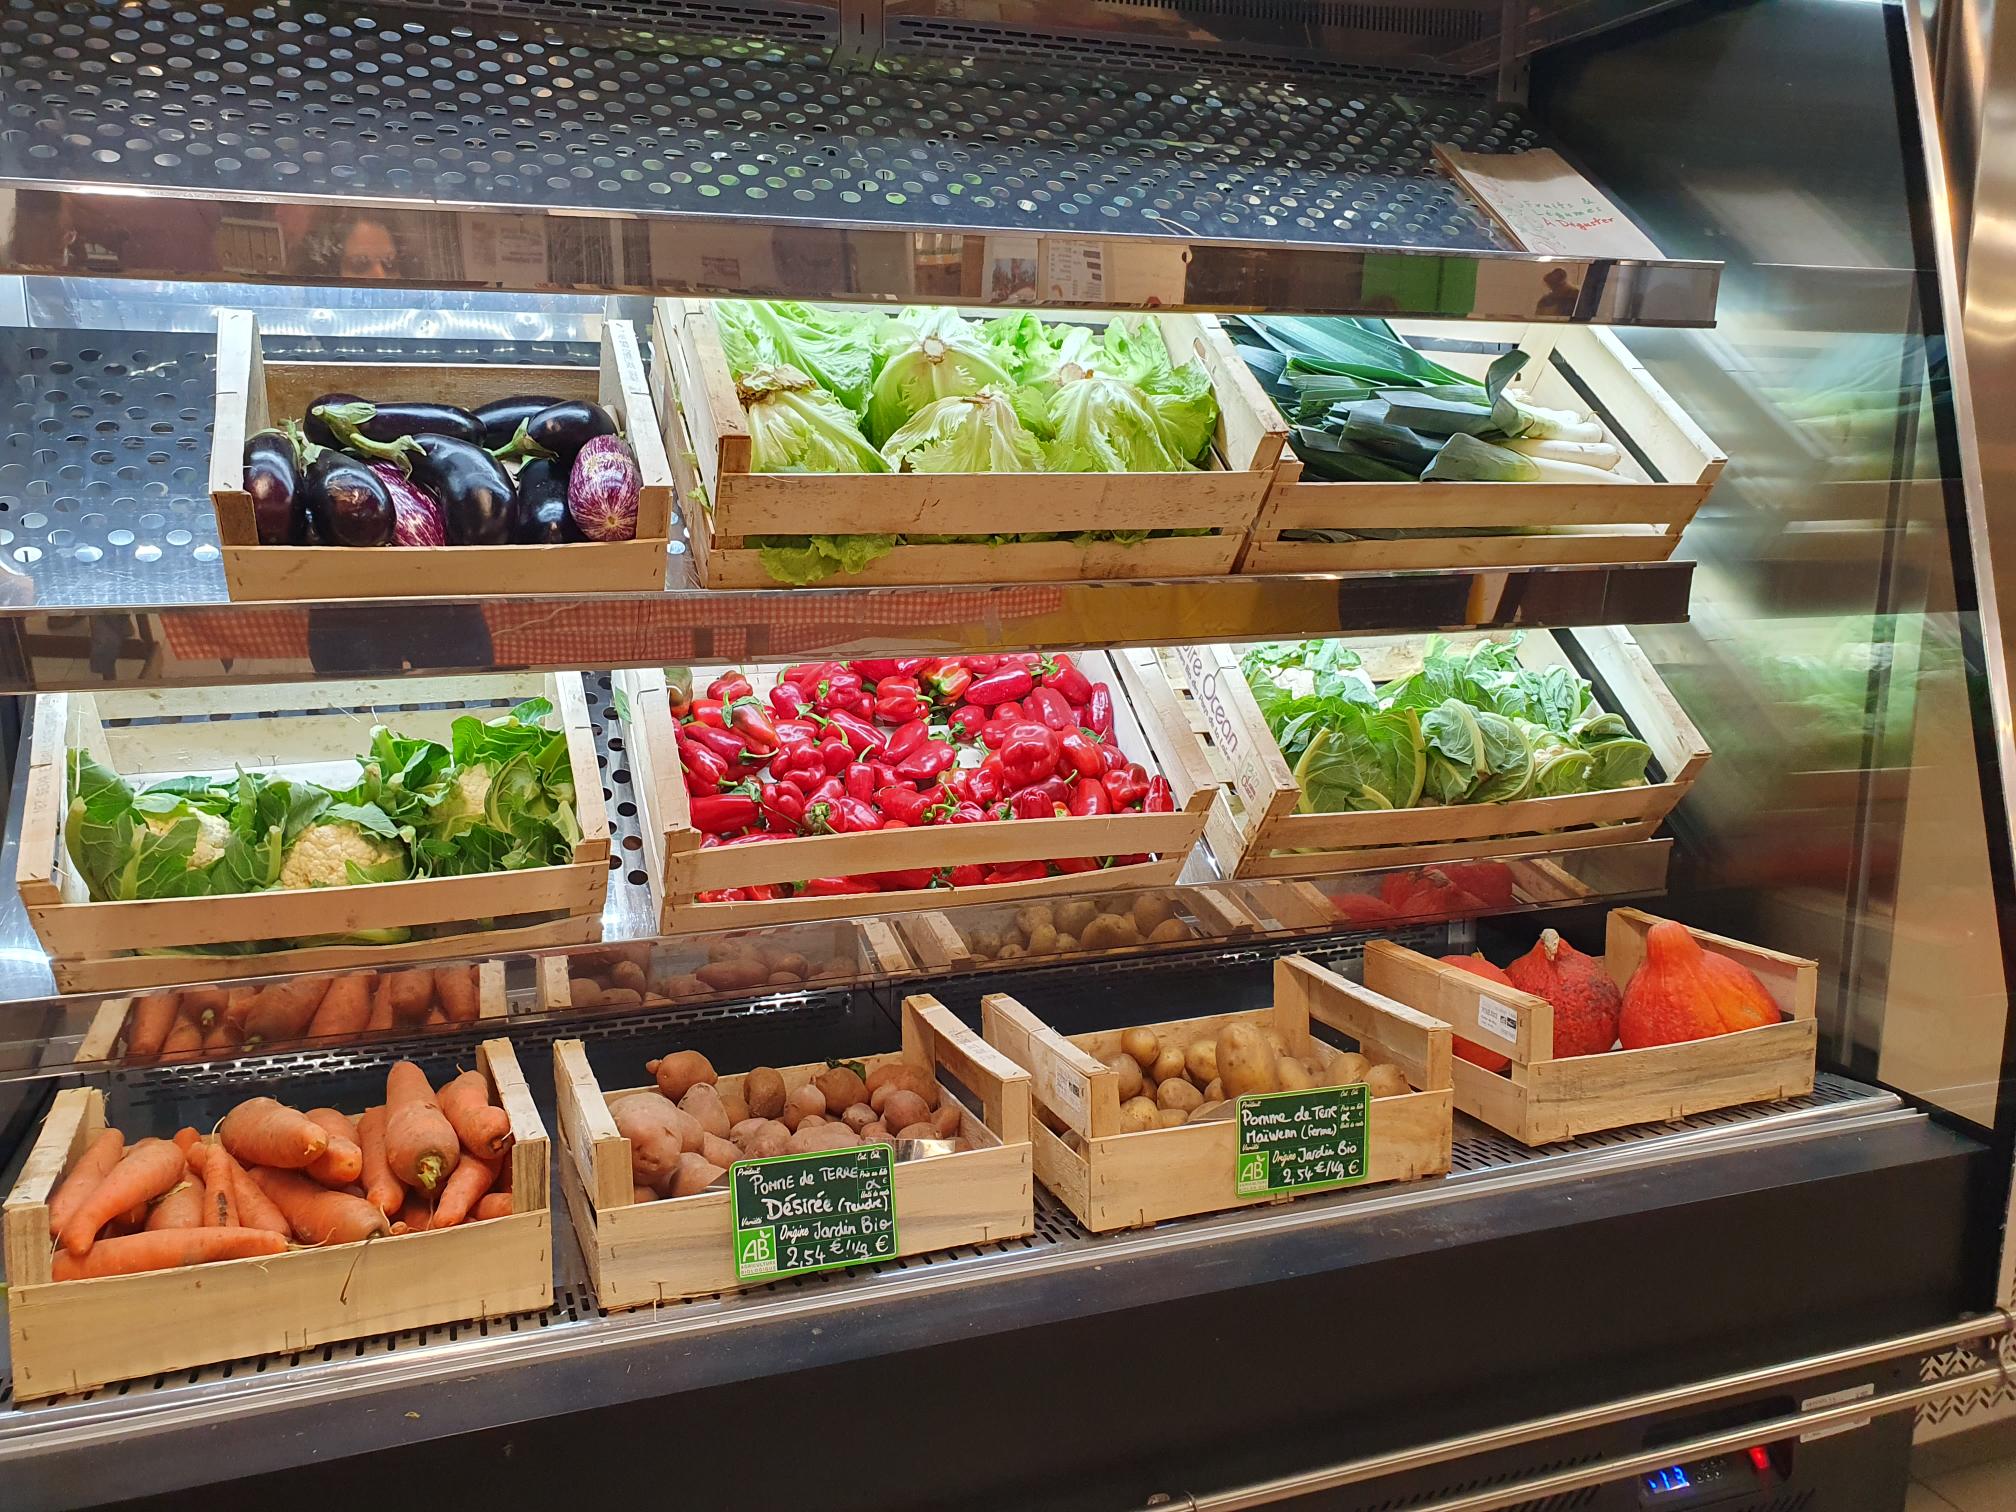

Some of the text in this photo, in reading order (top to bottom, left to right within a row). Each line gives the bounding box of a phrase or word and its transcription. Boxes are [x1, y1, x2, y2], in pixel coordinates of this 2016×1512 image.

[1202, 673, 1238, 753] Ocean
[1241, 1109, 1292, 1126] Pomme
[1294, 1105, 1311, 1121] de
[1297, 1144, 1334, 1163] Jardin
[1337, 1140, 1357, 1156] Bio
[799, 1170, 815, 1186] de
[819, 1166, 859, 1182] TERRE
[1240, 1161, 1264, 1182] AB
[1283, 1165, 1313, 1185] 2,54
[1348, 1159, 1360, 1174] €
[780, 1215, 892, 1244] Origine Jardin Bio
[742, 1238, 770, 1262] AB
[786, 1244, 826, 1268] 2,54
[875, 1235, 889, 1253] €
